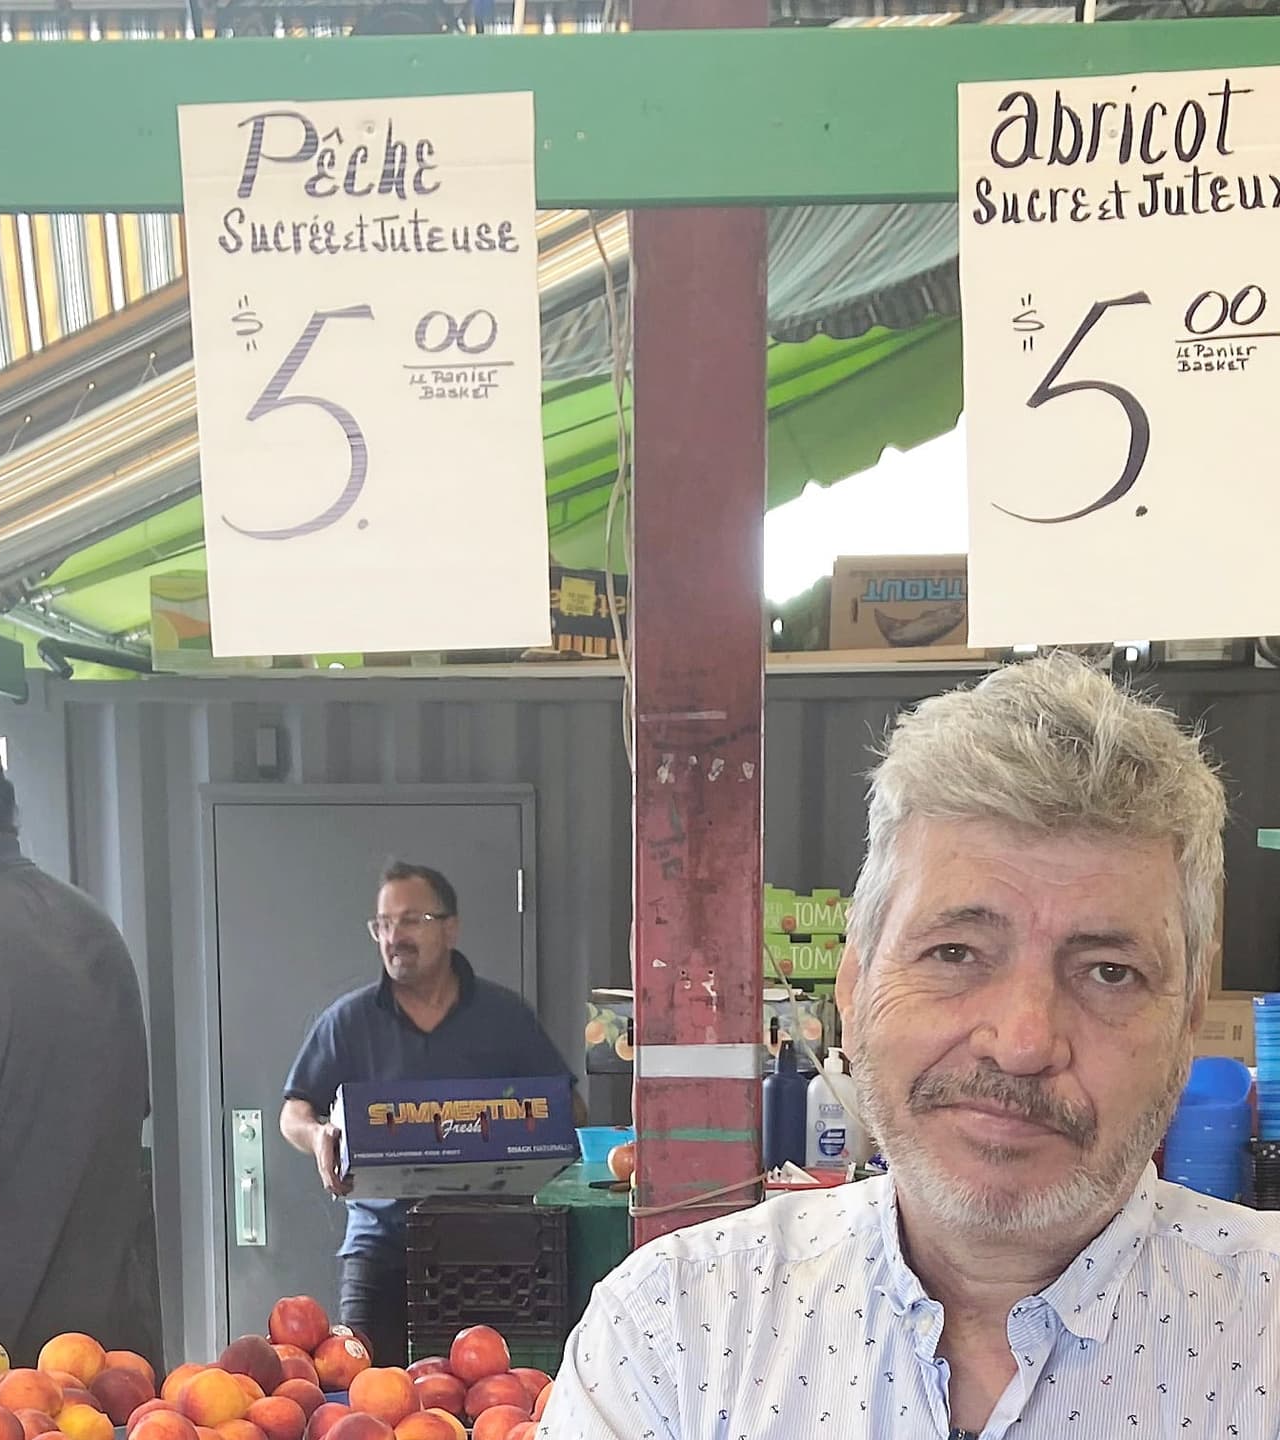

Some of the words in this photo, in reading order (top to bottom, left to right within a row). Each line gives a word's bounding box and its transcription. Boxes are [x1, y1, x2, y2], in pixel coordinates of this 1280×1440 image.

[990, 78, 1254, 169] abricot
[237, 110, 442, 199] Pêche
[1097, 180, 1128, 223] et
[218, 207, 341, 254] Sucrée
[343, 213, 369, 252] et
[415, 309, 498, 354] 00
[1185, 284, 1266, 335] 00
[441, 1117, 483, 1139] Fresh
